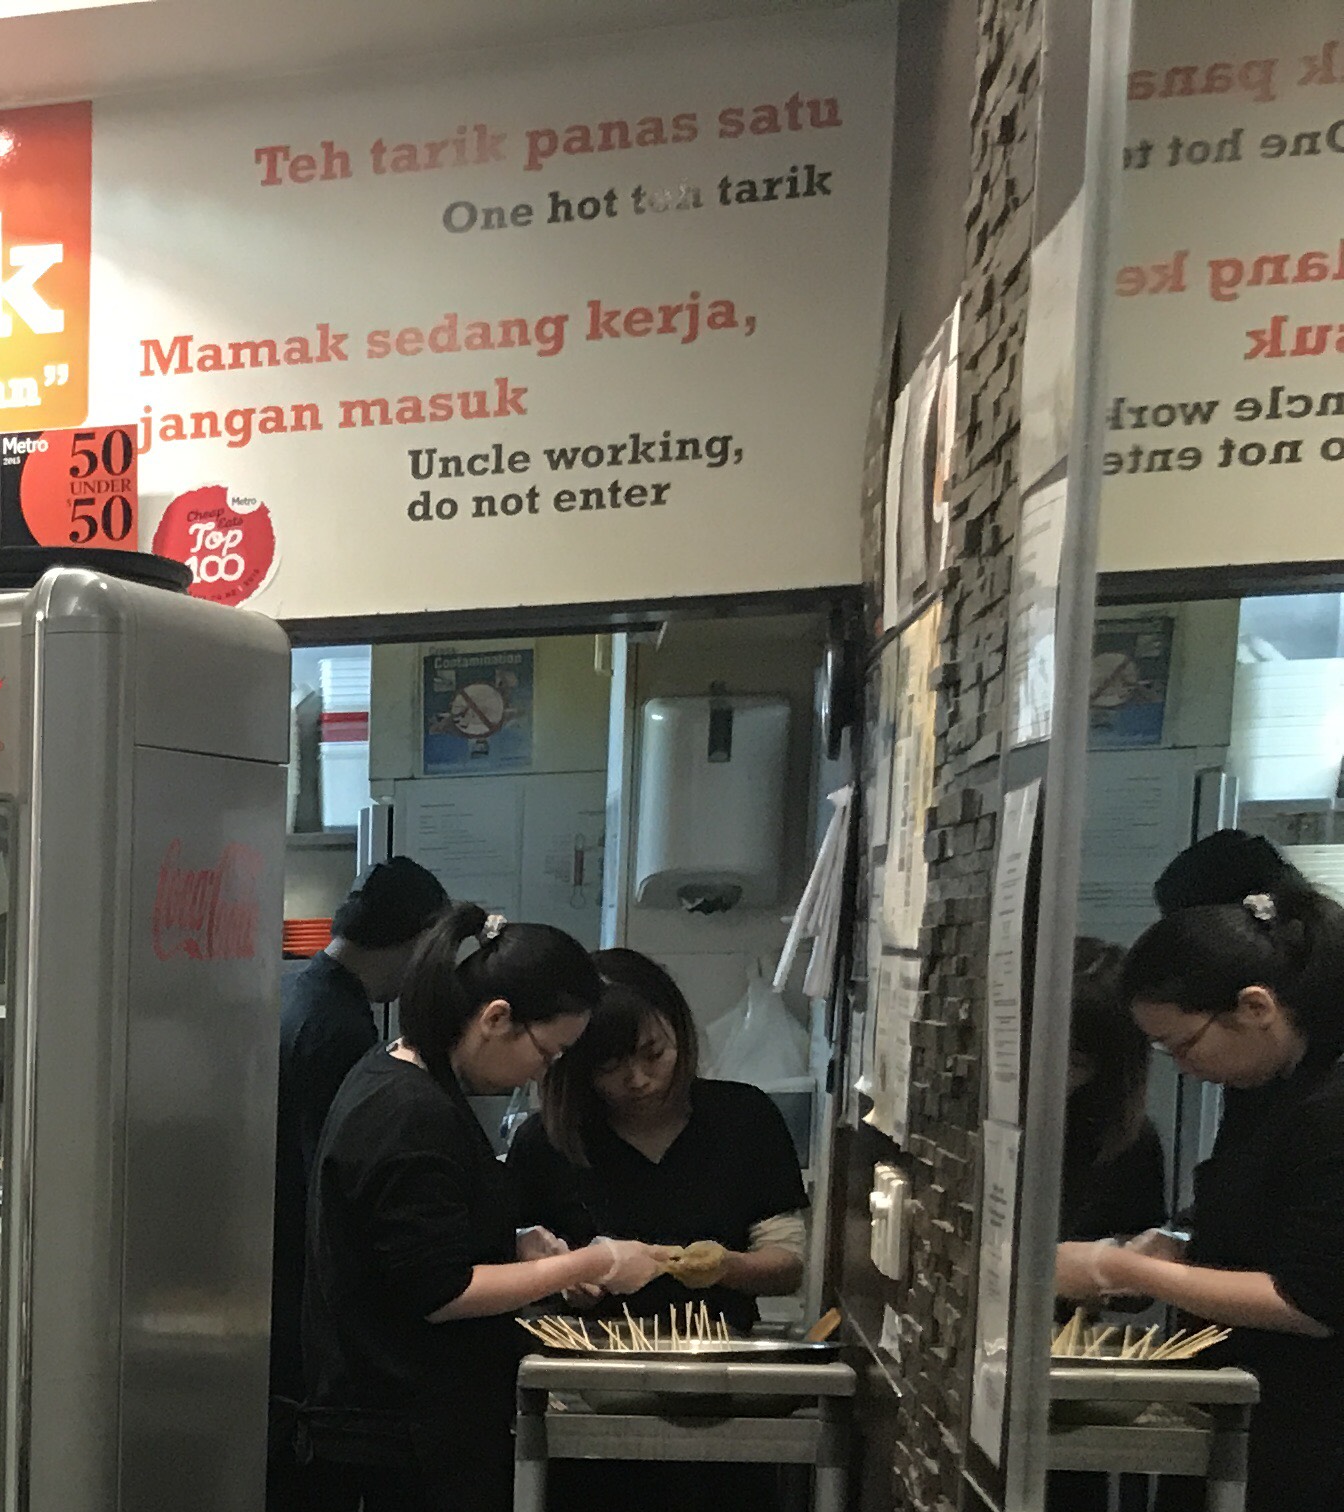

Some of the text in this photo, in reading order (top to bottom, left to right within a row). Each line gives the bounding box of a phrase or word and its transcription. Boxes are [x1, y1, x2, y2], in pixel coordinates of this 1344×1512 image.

[254, 91, 843, 188] Teh tarik panas satu
[441, 199, 534, 234] One
[546, 187, 618, 225] hot
[717, 163, 834, 208] tarik
[139, 291, 758, 378] Mamak sedang kerja,
[138, 377, 529, 455] jangan masuk
[2, 437, 49, 455] Metro
[69, 429, 133, 478] 50
[408, 429, 744, 480] Uncle working,
[70, 478, 131, 495] UNDER
[232, 497, 257, 505] Metro
[407, 476, 671, 522] do not enter
[188, 522, 243, 556] Top
[184, 554, 245, 583] 100
[434, 653, 523, 669] Contamination
